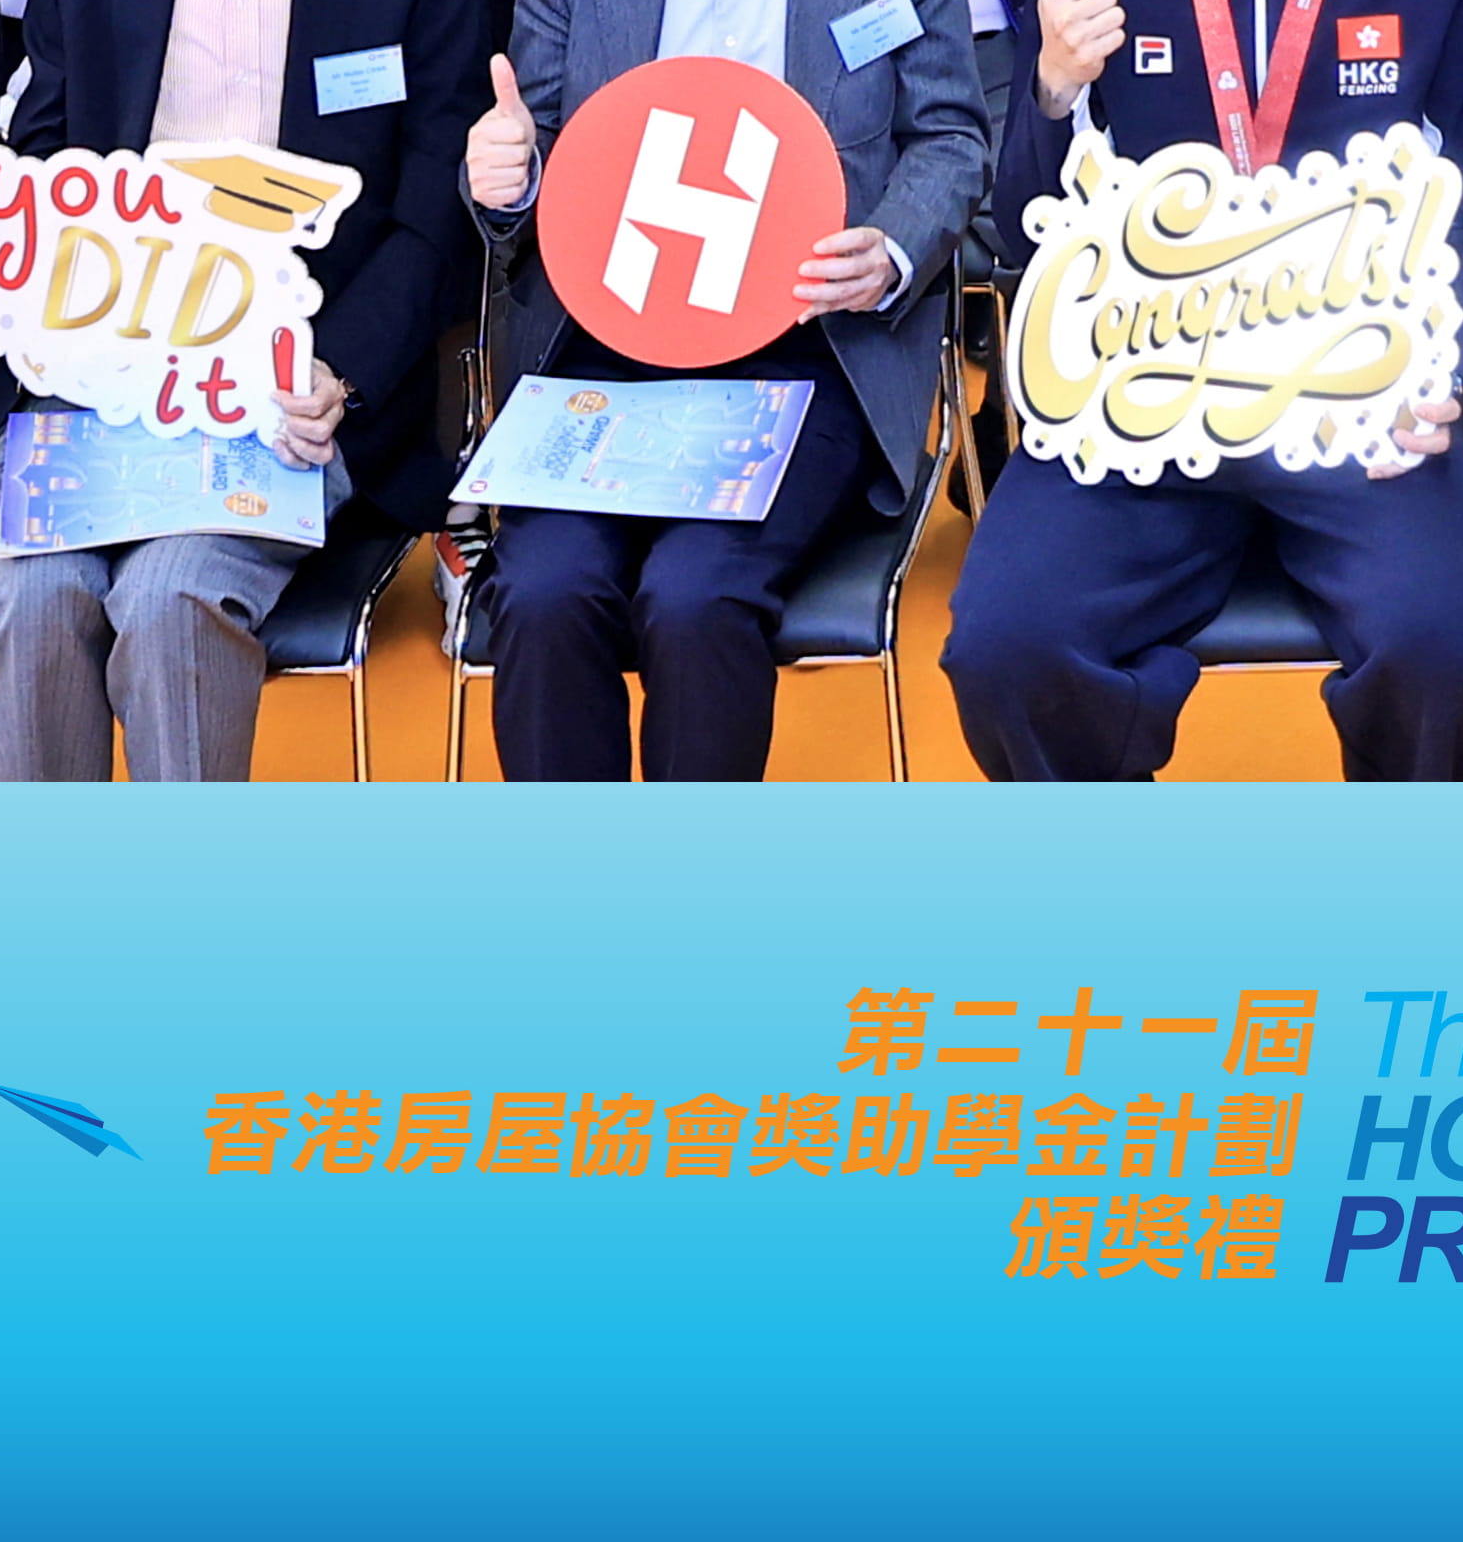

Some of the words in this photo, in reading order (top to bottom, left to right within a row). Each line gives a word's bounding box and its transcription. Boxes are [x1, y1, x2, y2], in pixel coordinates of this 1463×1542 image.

[1339, 60, 1399, 85] HKG
[1339, 83, 1397, 96] FENCING
[41, 224, 255, 348] DID
